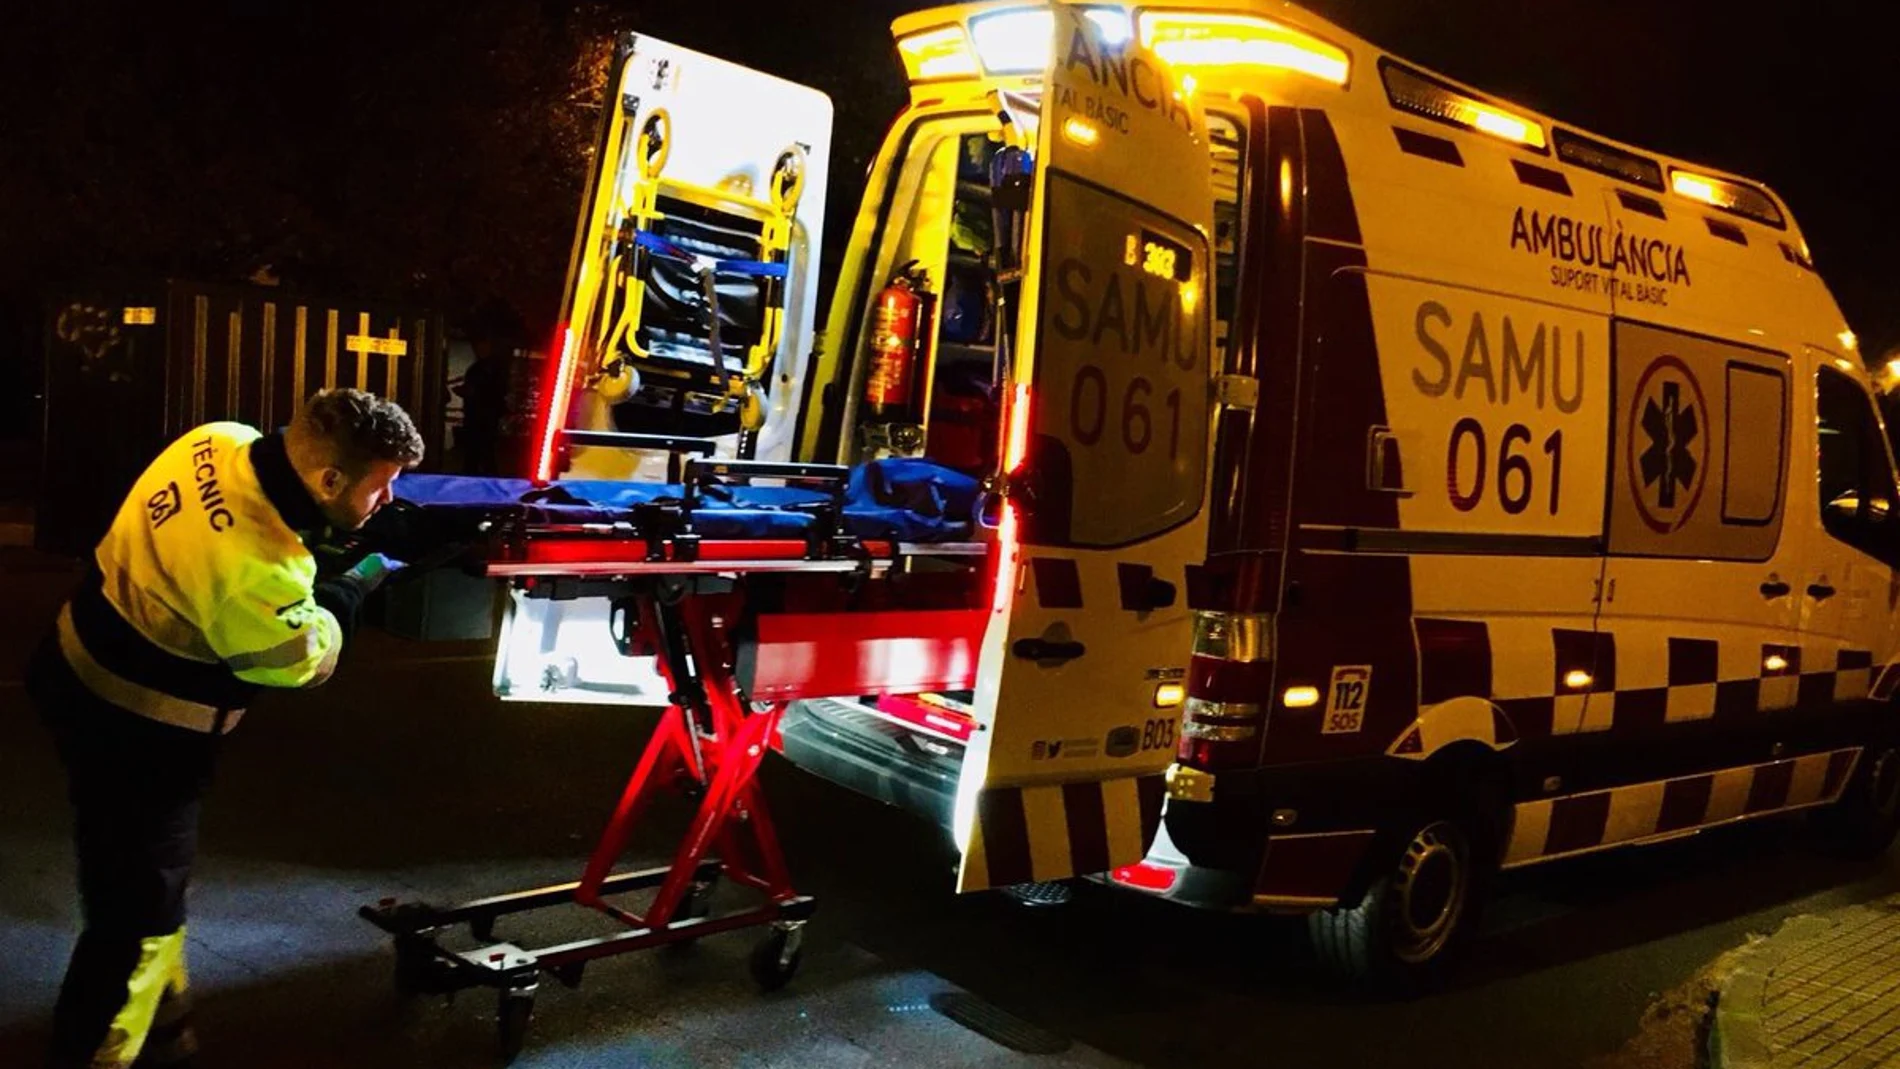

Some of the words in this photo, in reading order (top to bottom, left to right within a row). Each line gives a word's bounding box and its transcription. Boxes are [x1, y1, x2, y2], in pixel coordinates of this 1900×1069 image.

[1510, 206, 1691, 287] AMBULÀNCIA
[1054, 257, 1198, 372] SAMU
[1411, 300, 1585, 414] SAMU
[1070, 365, 1183, 461] 061
[1447, 417, 1563, 517] 061
[1142, 719, 1175, 751] B03
[1330, 712, 1359, 731] SOS
[1335, 681, 1363, 710] 112
